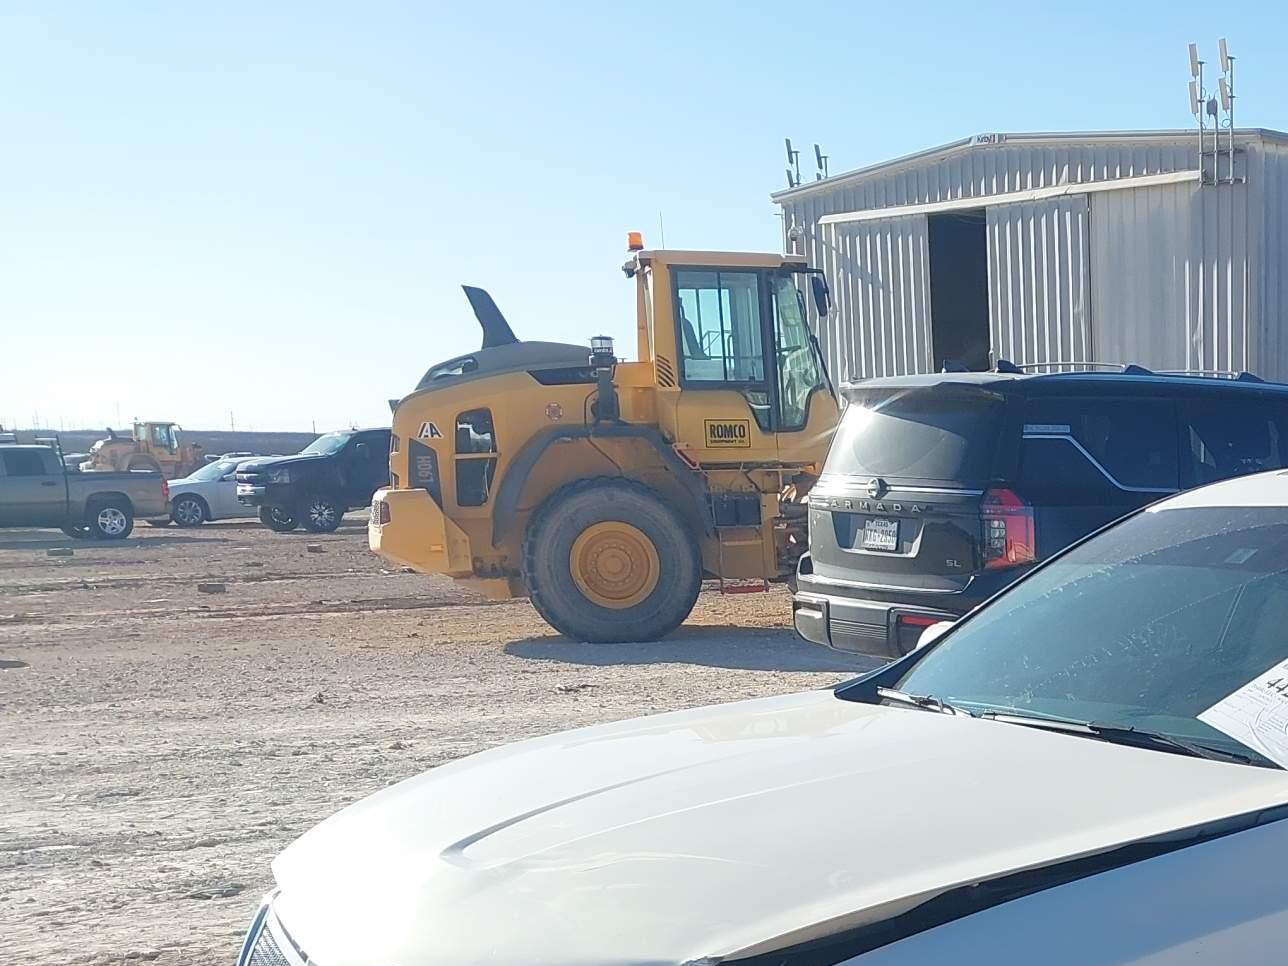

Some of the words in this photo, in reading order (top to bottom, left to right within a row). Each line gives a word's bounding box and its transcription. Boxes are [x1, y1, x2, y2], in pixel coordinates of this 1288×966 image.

[709, 423, 746, 439] ROMCO
[416, 455, 435, 482] L90H
[831, 499, 921, 513] ARMADA
[945, 559, 961, 567] SL
